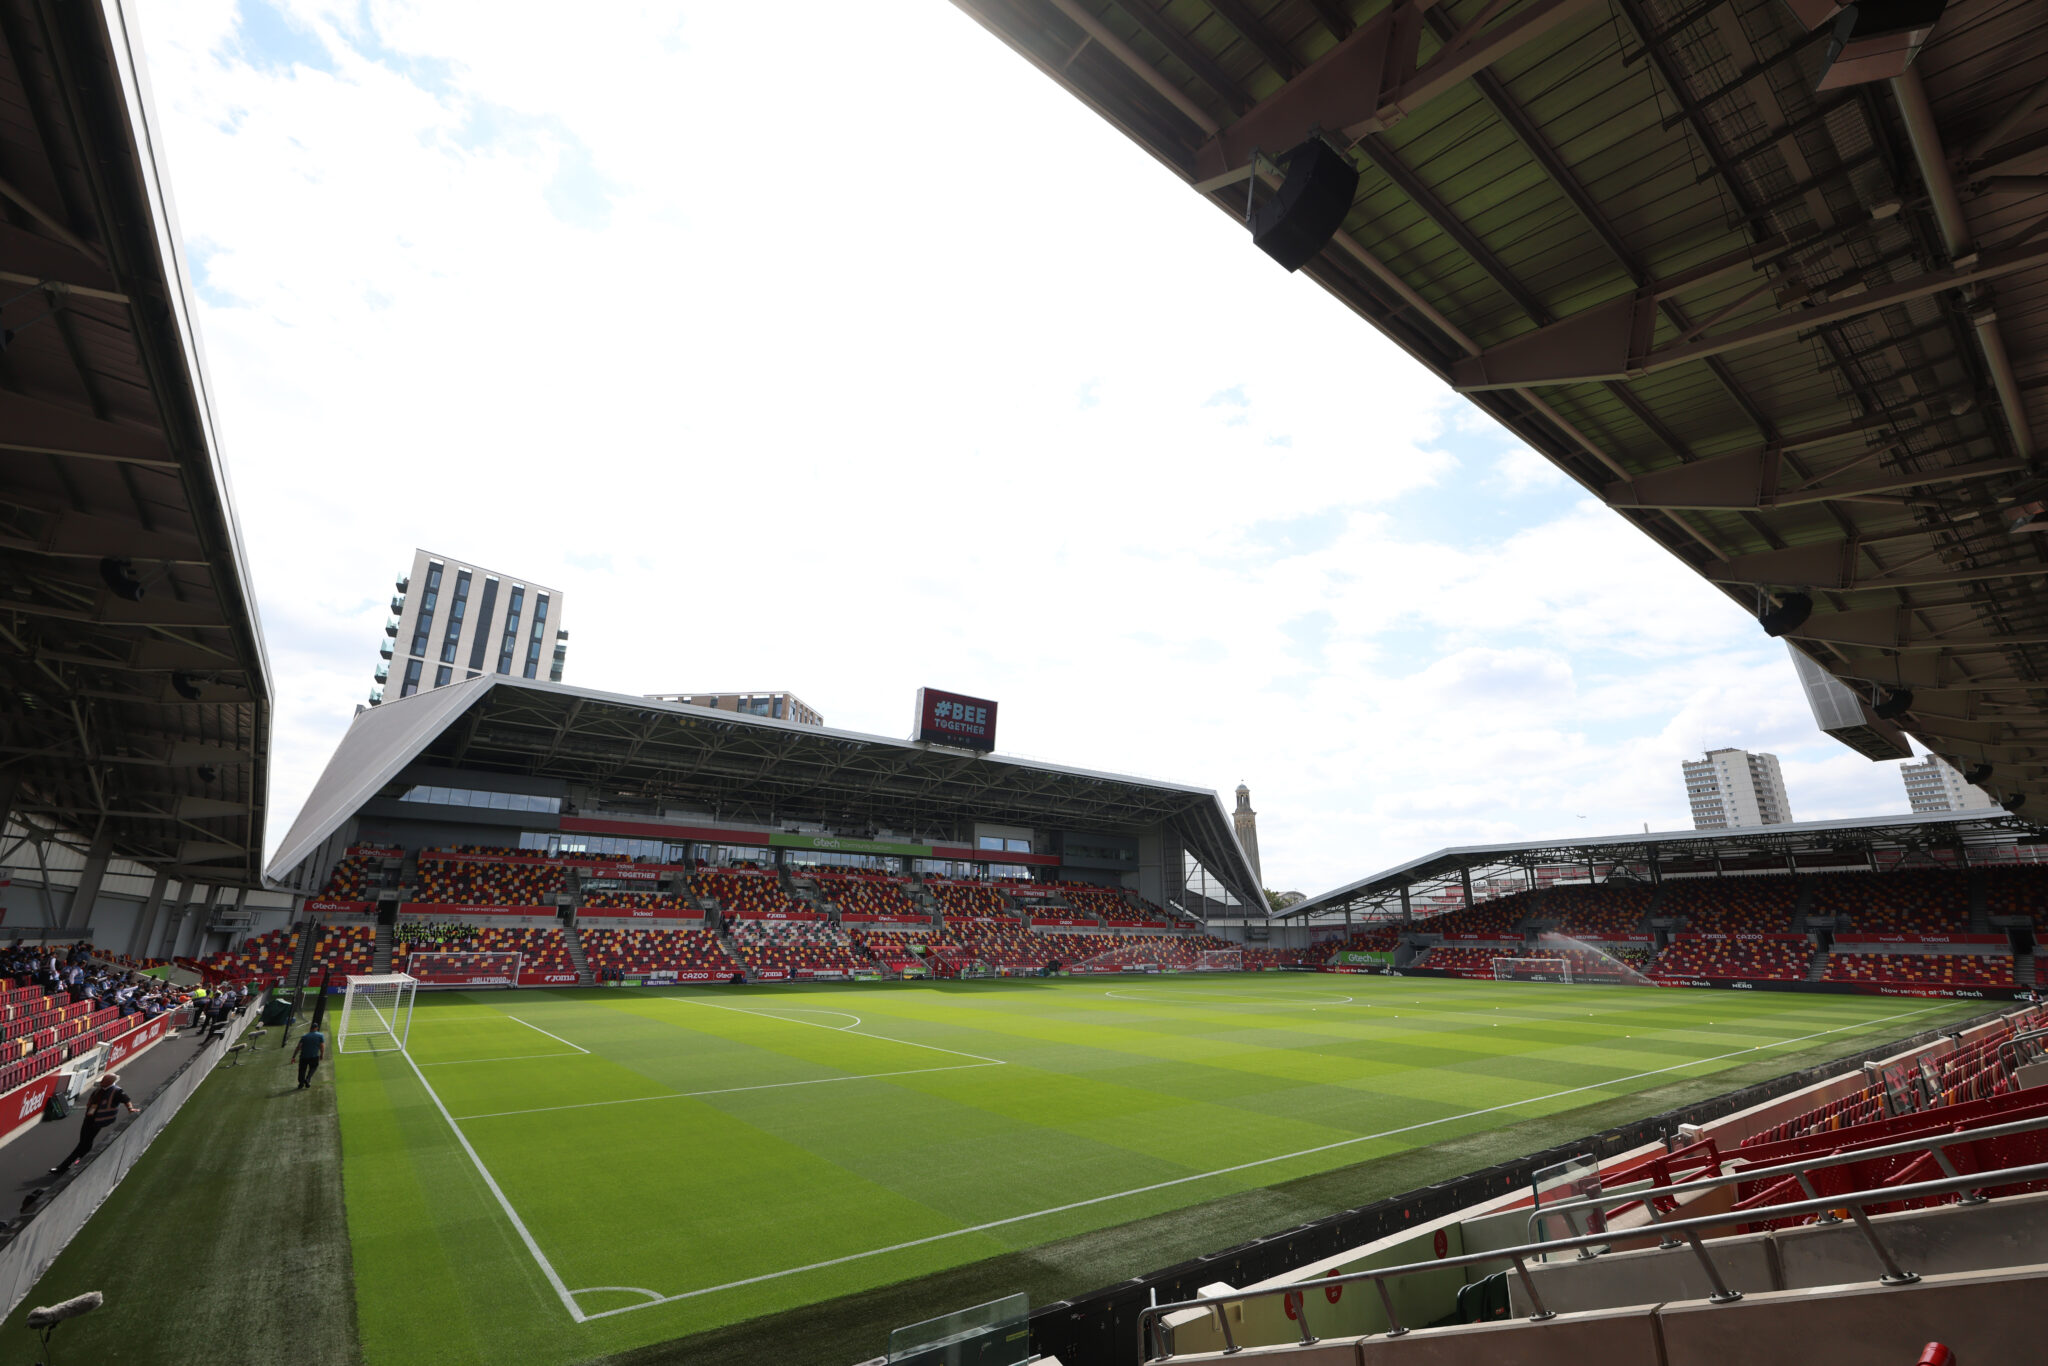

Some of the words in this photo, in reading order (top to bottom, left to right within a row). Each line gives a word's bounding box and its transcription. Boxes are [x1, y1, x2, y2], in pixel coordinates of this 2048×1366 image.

[935, 701, 986, 725] #BEE
[934, 718, 984, 735] TOGETHER
[813, 838, 840, 848] Gtech
[618, 871, 656, 879] TOGETHER
[682, 972, 709, 980] CAZOO
[1900, 989, 1926, 997] serving
[1956, 989, 1983, 998] Gtech
[18, 1084, 48, 1121] indeed
